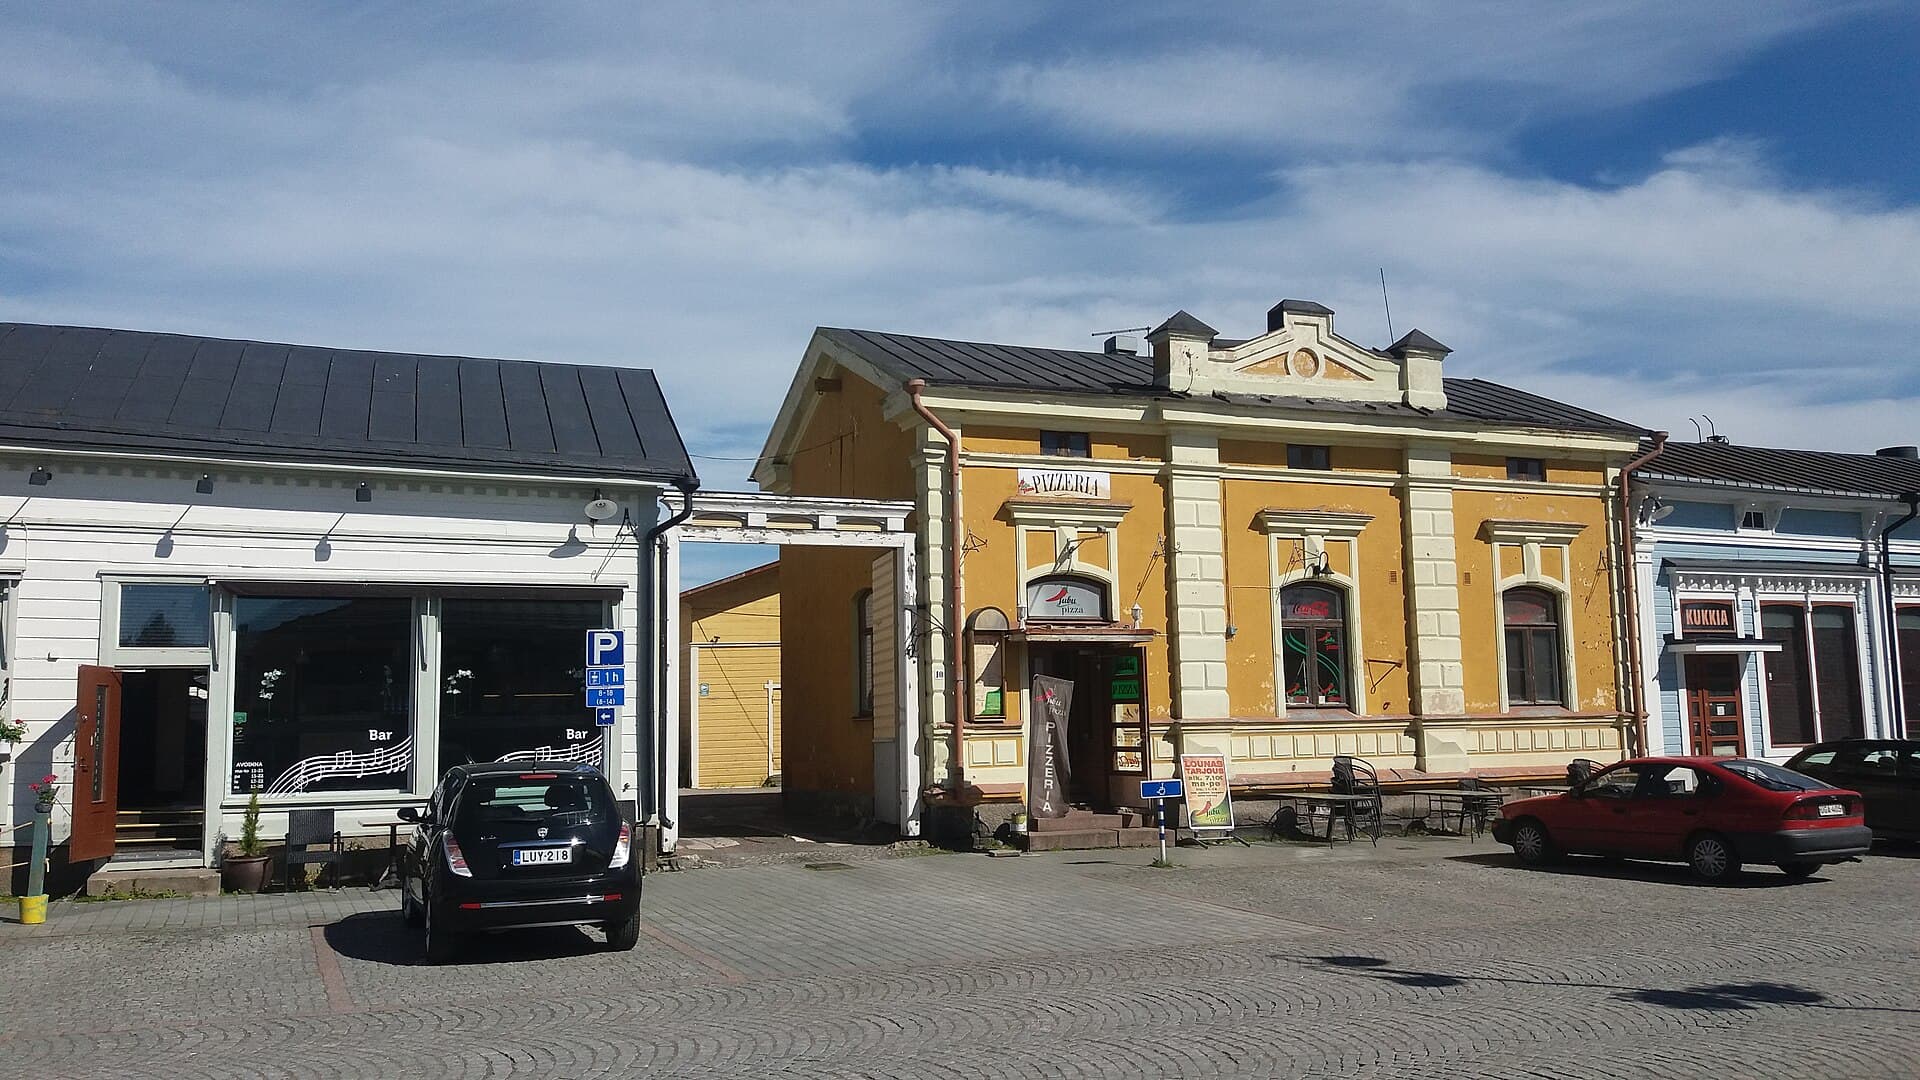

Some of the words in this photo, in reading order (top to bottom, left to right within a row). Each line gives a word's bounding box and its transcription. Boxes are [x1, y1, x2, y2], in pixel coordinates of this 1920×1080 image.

[1032, 473, 1098, 496] PIZZERIA
[1686, 609, 1729, 625] KUKKIA
[593, 632, 618, 665] P
[605, 672, 609, 682] 1
[612, 672, 619, 682] h
[369, 729, 393, 741] Bar
[566, 729, 588, 740] Bar
[1043, 721, 1056, 812] PIZZERIA
[522, 850, 569, 863] LUY-218
